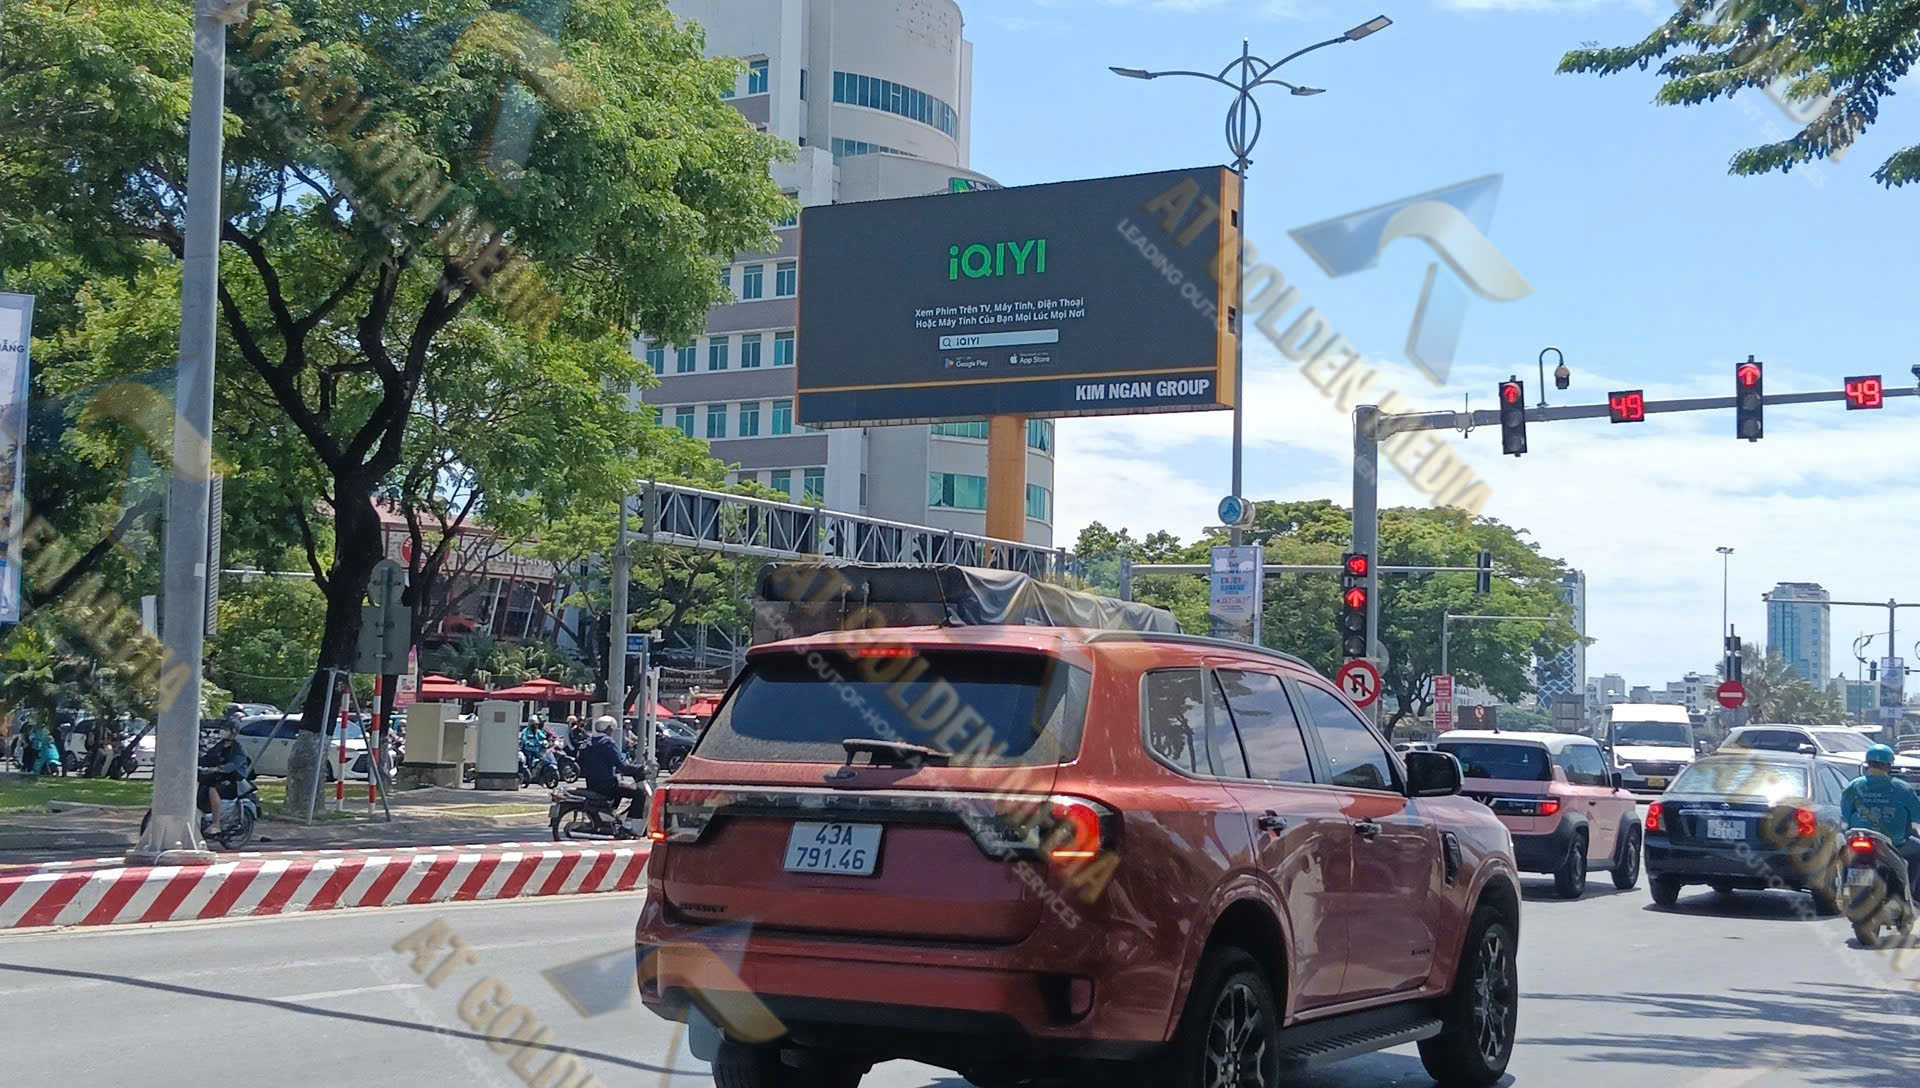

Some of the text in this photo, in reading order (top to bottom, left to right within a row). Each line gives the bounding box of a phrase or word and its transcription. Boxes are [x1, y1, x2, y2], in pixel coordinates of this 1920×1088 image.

[949, 239, 1046, 280] iQIYI
[915, 309, 934, 317] Xem
[936, 307, 957, 316] Phim
[959, 305, 978, 314] Trên
[980, 304, 992, 313] TV,
[994, 303, 1012, 313] Máy
[1059, 297, 1084, 307] Thoại
[938, 318, 956, 328] Máy
[958, 316, 977, 325] Tính
[978, 314, 996, 325] Của
[997, 313, 1013, 324] Bạn
[1033, 311, 1049, 320] Lúc
[1050, 310, 1067, 320] Mọi
[1068, 308, 1085, 318] Nơi
[0, 339, 25, 353] ẴNG
[976, 359, 988, 368] Play
[1034, 356, 1051, 364] Store
[1076, 379, 1210, 400] KIM NGAN GROUP
[1846, 380, 1880, 406] 49
[1611, 394, 1642, 419] 49
[1349, 559, 1366, 573] 49
[816, 825, 852, 846] 43A
[796, 847, 866, 870] 791.46
